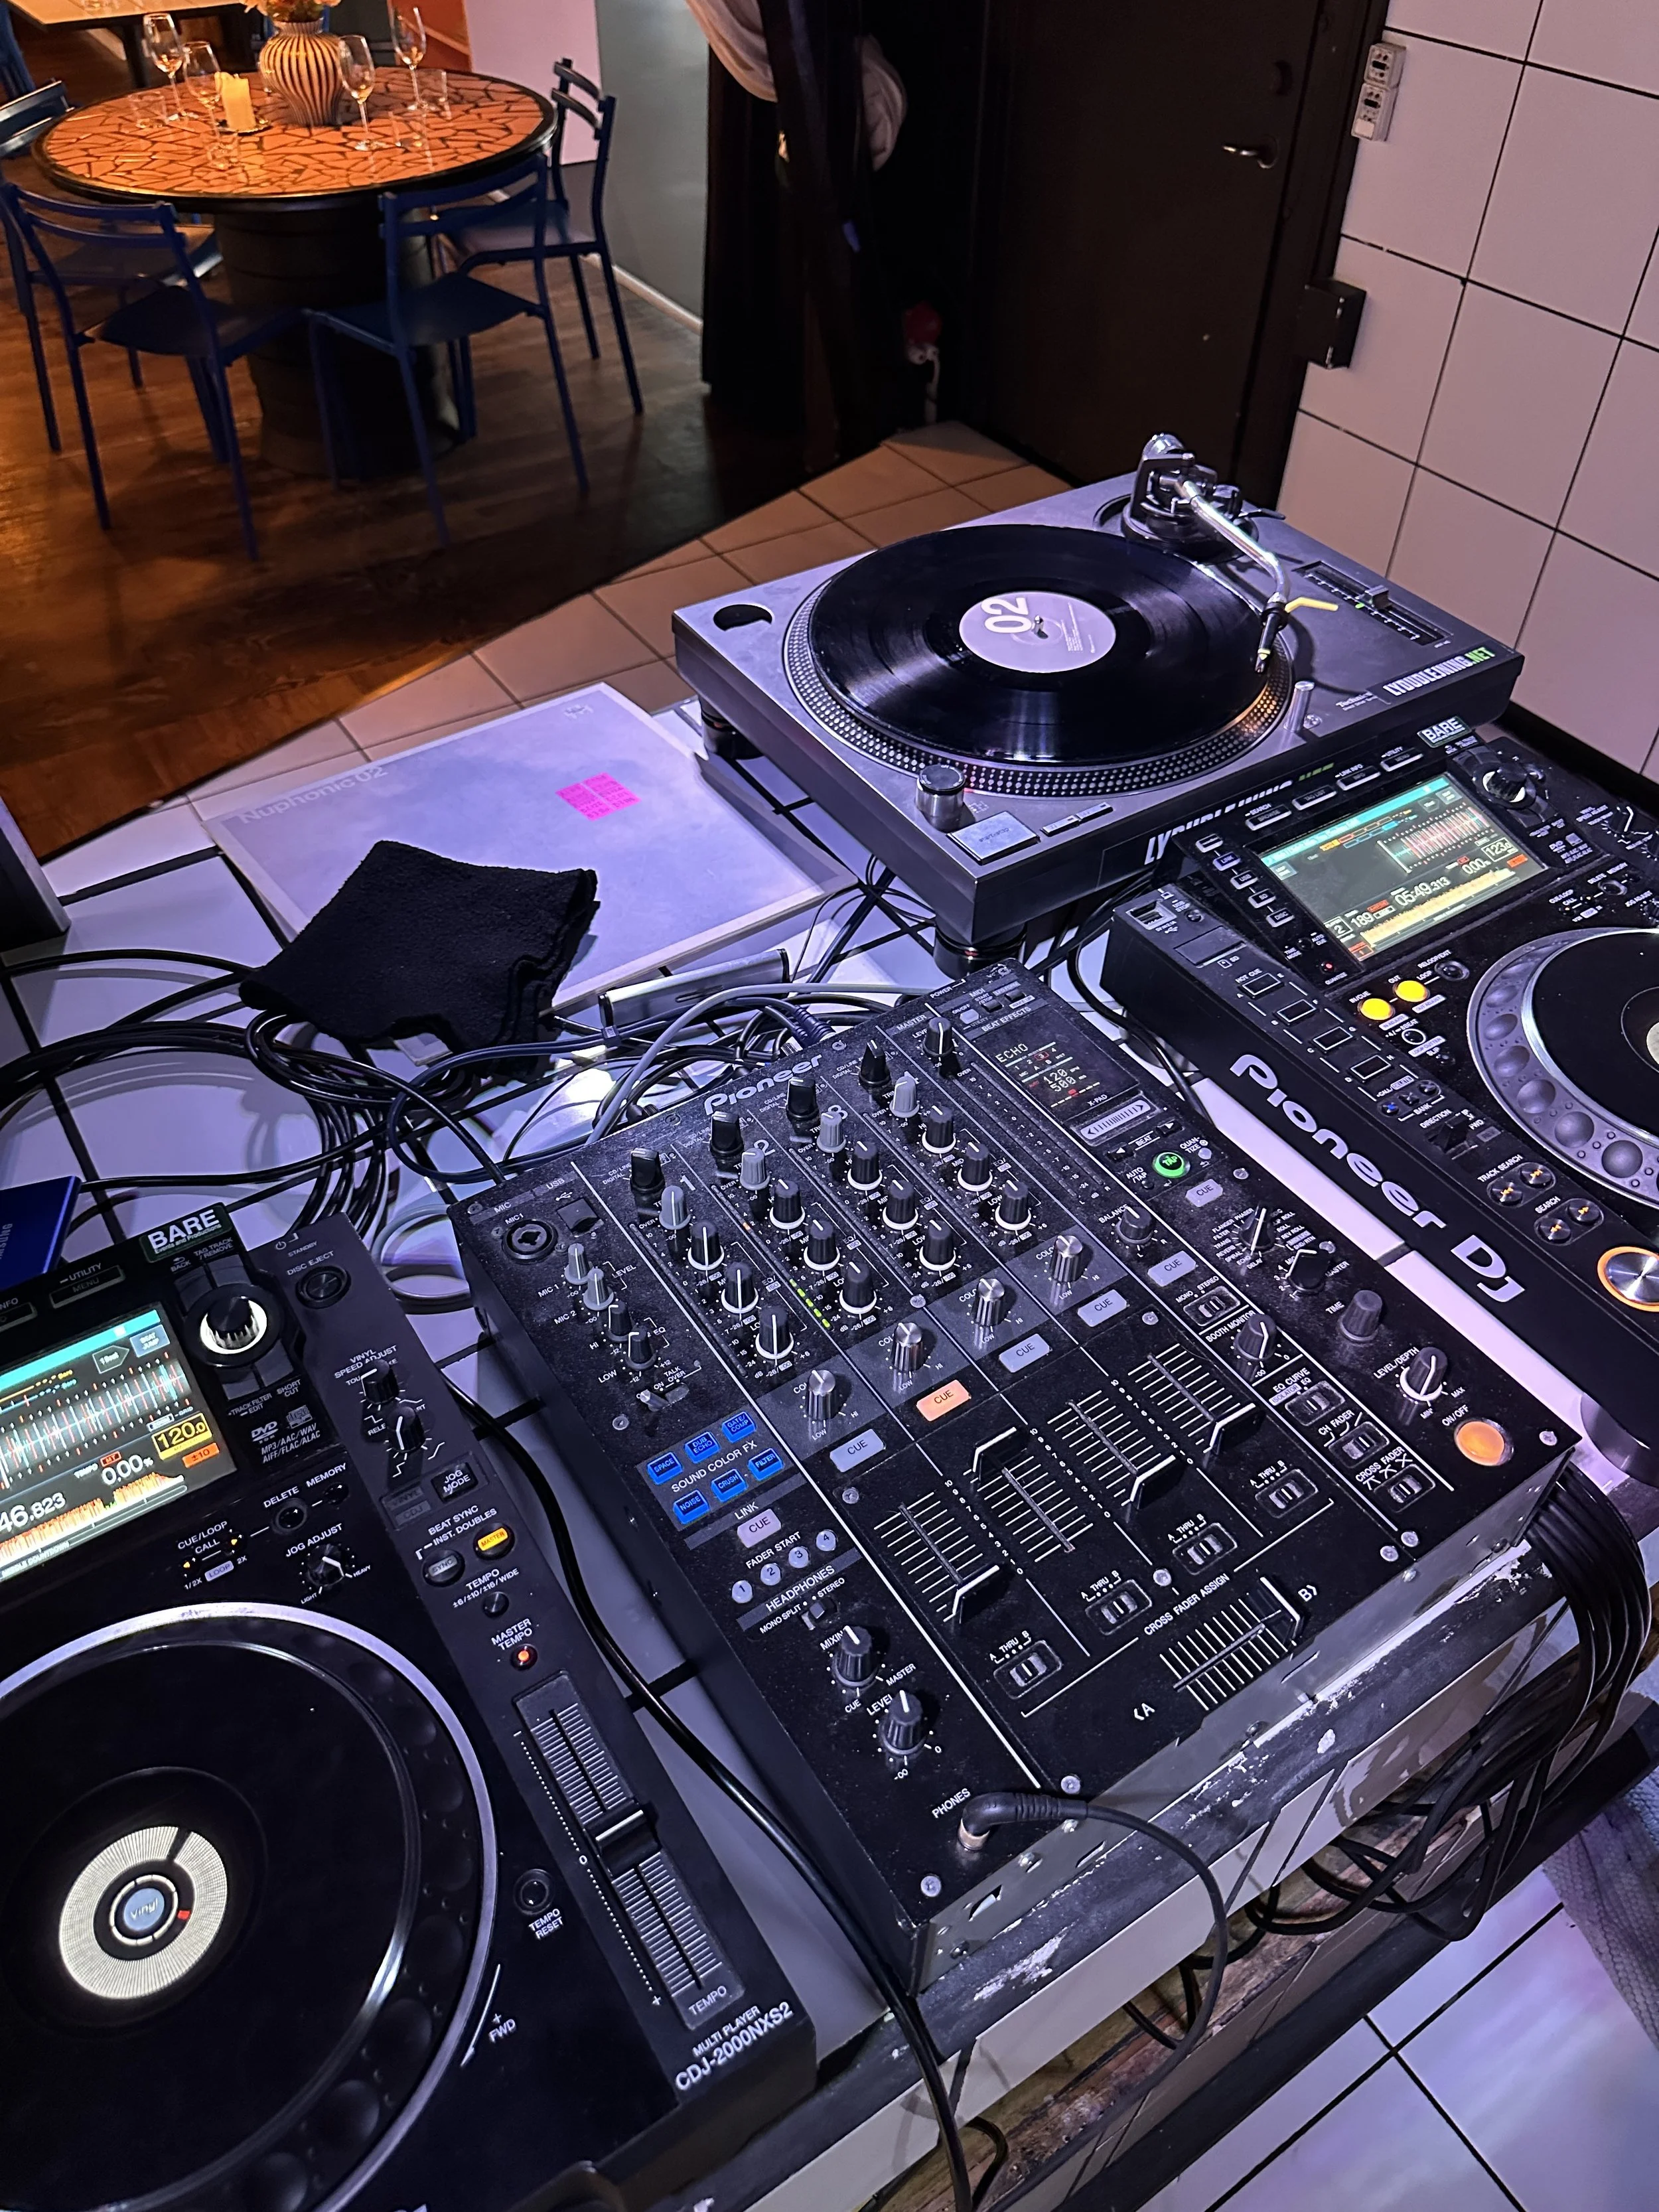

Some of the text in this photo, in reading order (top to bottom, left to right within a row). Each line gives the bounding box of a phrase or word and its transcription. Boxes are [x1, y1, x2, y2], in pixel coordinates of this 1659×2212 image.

[981, 597, 1033, 634] 02
[1421, 717, 1463, 743] BARE
[237, 778, 355, 824] Nuphonic
[1250, 803, 1271, 815] SEARCH
[1394, 876, 1451, 907] 05:49.313
[1351, 912, 1374, 928] 189
[1417, 949, 1452, 969] RELOOP/EXIT
[1235, 968, 1263, 984] HOT CUE
[1388, 975, 1402, 984] OUT
[1417, 970, 1433, 981] LOOP
[1349, 991, 1372, 1004] IN/CUE
[897, 1014, 927, 1031] MASTER
[981, 1006, 1031, 1032] BEAT EFFECTS
[995, 1043, 1028, 1063] ECHO
[703, 1054, 822, 1116] Pioneer
[1043, 1069, 1068, 1084] 120
[1087, 1094, 1108, 1107] X-PAD
[1413, 1102, 1431, 1115] BANK
[1419, 1109, 1452, 1128] DIRECTION
[1135, 1134, 1152, 1147] BEAT
[1126, 1167, 1144, 1179] AUTO
[1477, 1154, 1523, 1183] TRACK SEARCH
[546, 1178, 565, 1190] USB
[720, 1179, 737, 1191] OVER
[1230, 1054, 1526, 1302] Pioneer DJ
[1196, 1184, 1214, 1196] CUE
[494, 1202, 512, 1214] MIC
[1099, 1204, 1129, 1224] BALANCE
[1535, 1196, 1561, 1214] SEARCH
[148, 1209, 220, 1250] BARE
[638, 1218, 656, 1230] OVER
[154, 1223, 222, 1254] Events and Productions
[194, 1238, 234, 1256] TAG TRACK
[288, 1241, 317, 1257] STANDBY
[171, 1260, 191, 1272] BACK
[287, 1250, 334, 1276] DISC EJECT
[1164, 1258, 1183, 1272] CUE
[1236, 1255, 1251, 1266] ECHO
[69, 1264, 102, 1282] UTILITY
[612, 1265, 637, 1279] LEVEL
[72, 1278, 99, 1293] MENU
[538, 1286, 553, 1298] MIC
[1175, 1276, 1220, 1303] MONO STEREO
[1094, 1298, 1114, 1313] CUE
[1325, 1301, 1344, 1315] TIME
[554, 1313, 570, 1325] MIC
[1205, 1309, 1256, 1343] BOOTH MONITOR
[350, 1349, 376, 1364] VINYL
[1015, 1343, 1035, 1358] CUE
[334, 1345, 397, 1378] SPEED ADJUST
[1373, 1347, 1420, 1380] LEVEL/DEPTH
[598, 1370, 617, 1384] LOW
[664, 1365, 682, 1377] TALK
[277, 1379, 301, 1396] SHORT
[1272, 1367, 1310, 1394] EQ CURVE
[934, 1390, 954, 1405] CUE
[1271, 1377, 1311, 1403] ISOLATOR EQ
[1451, 1386, 1465, 1399] MAX
[231, 1393, 273, 1416] TRACK FILTER
[1318, 1410, 1355, 1436] CH FADER
[1441, 1404, 1470, 1427] ON/OFF
[158, 1421, 206, 1449] 120.0
[261, 1423, 317, 1455] MP3/AAC/WAV
[811, 1428, 828, 1441] LOW
[191, 1448, 210, 1462] ±10
[263, 1430, 321, 1463] AIFF/FLAC/ALAC
[693, 1440, 713, 1453] ECHO
[847, 1439, 869, 1455] CUE
[654, 1458, 675, 1473] SPACE
[671, 1440, 758, 1493] SOUND COLOR FX
[755, 1453, 776, 1469] FILTER
[1355, 1446, 1406, 1483] CROSS FADER
[306, 1462, 347, 1488] MEMORY
[445, 1469, 463, 1483] JOG
[1258, 1465, 1275, 1480] THRU
[443, 1474, 471, 1495] MODE
[717, 1474, 739, 1490] CRUSH
[263, 1486, 299, 1509] DELETE
[680, 1495, 701, 1511] NOISE
[429, 1505, 478, 1535] BEAT SYNC
[734, 1502, 758, 1520] LINK
[433, 1508, 497, 1546] INST. DOUBLES
[749, 1516, 771, 1534] CUE
[1176, 1518, 1194, 1534] THRU
[178, 1520, 228, 1550] CUE/LOOP
[285, 1523, 343, 1557] JOG ADJUST
[480, 1531, 505, 1547] MASTER
[194, 1538, 220, 1554] CALL
[745, 1531, 801, 1570] FADER START
[353, 1565, 371, 1578] HEAVY
[431, 1558, 454, 1574] SYNC
[467, 1569, 500, 1591] TEMPO
[765, 1565, 836, 1612] HEADPHONES
[818, 1577, 845, 1598] STEREO
[1090, 1576, 1109, 1592] THRU
[301, 1593, 318, 1604] LIGHT
[1143, 1573, 1230, 1636] CROSS FADER ASSIGN
[760, 1604, 801, 1634] MONO SPLIT
[491, 1618, 532, 1646] MASTER
[498, 1628, 533, 1651] TEMPO
[999, 1637, 1019, 1654] THRU
[886, 1663, 916, 1686] MASTER
[844, 1700, 861, 1714] CUE
[931, 1787, 972, 1818] PHONES
[530, 1908, 560, 1933] TEMPO
[536, 1917, 564, 1940] RESET
[688, 1985, 727, 2018] TEMPO
[489, 2018, 517, 2043] FWD
[693, 2006, 760, 2057] MULTI PLAYER
[675, 2001, 794, 2091] CDJ-2000NXS2
